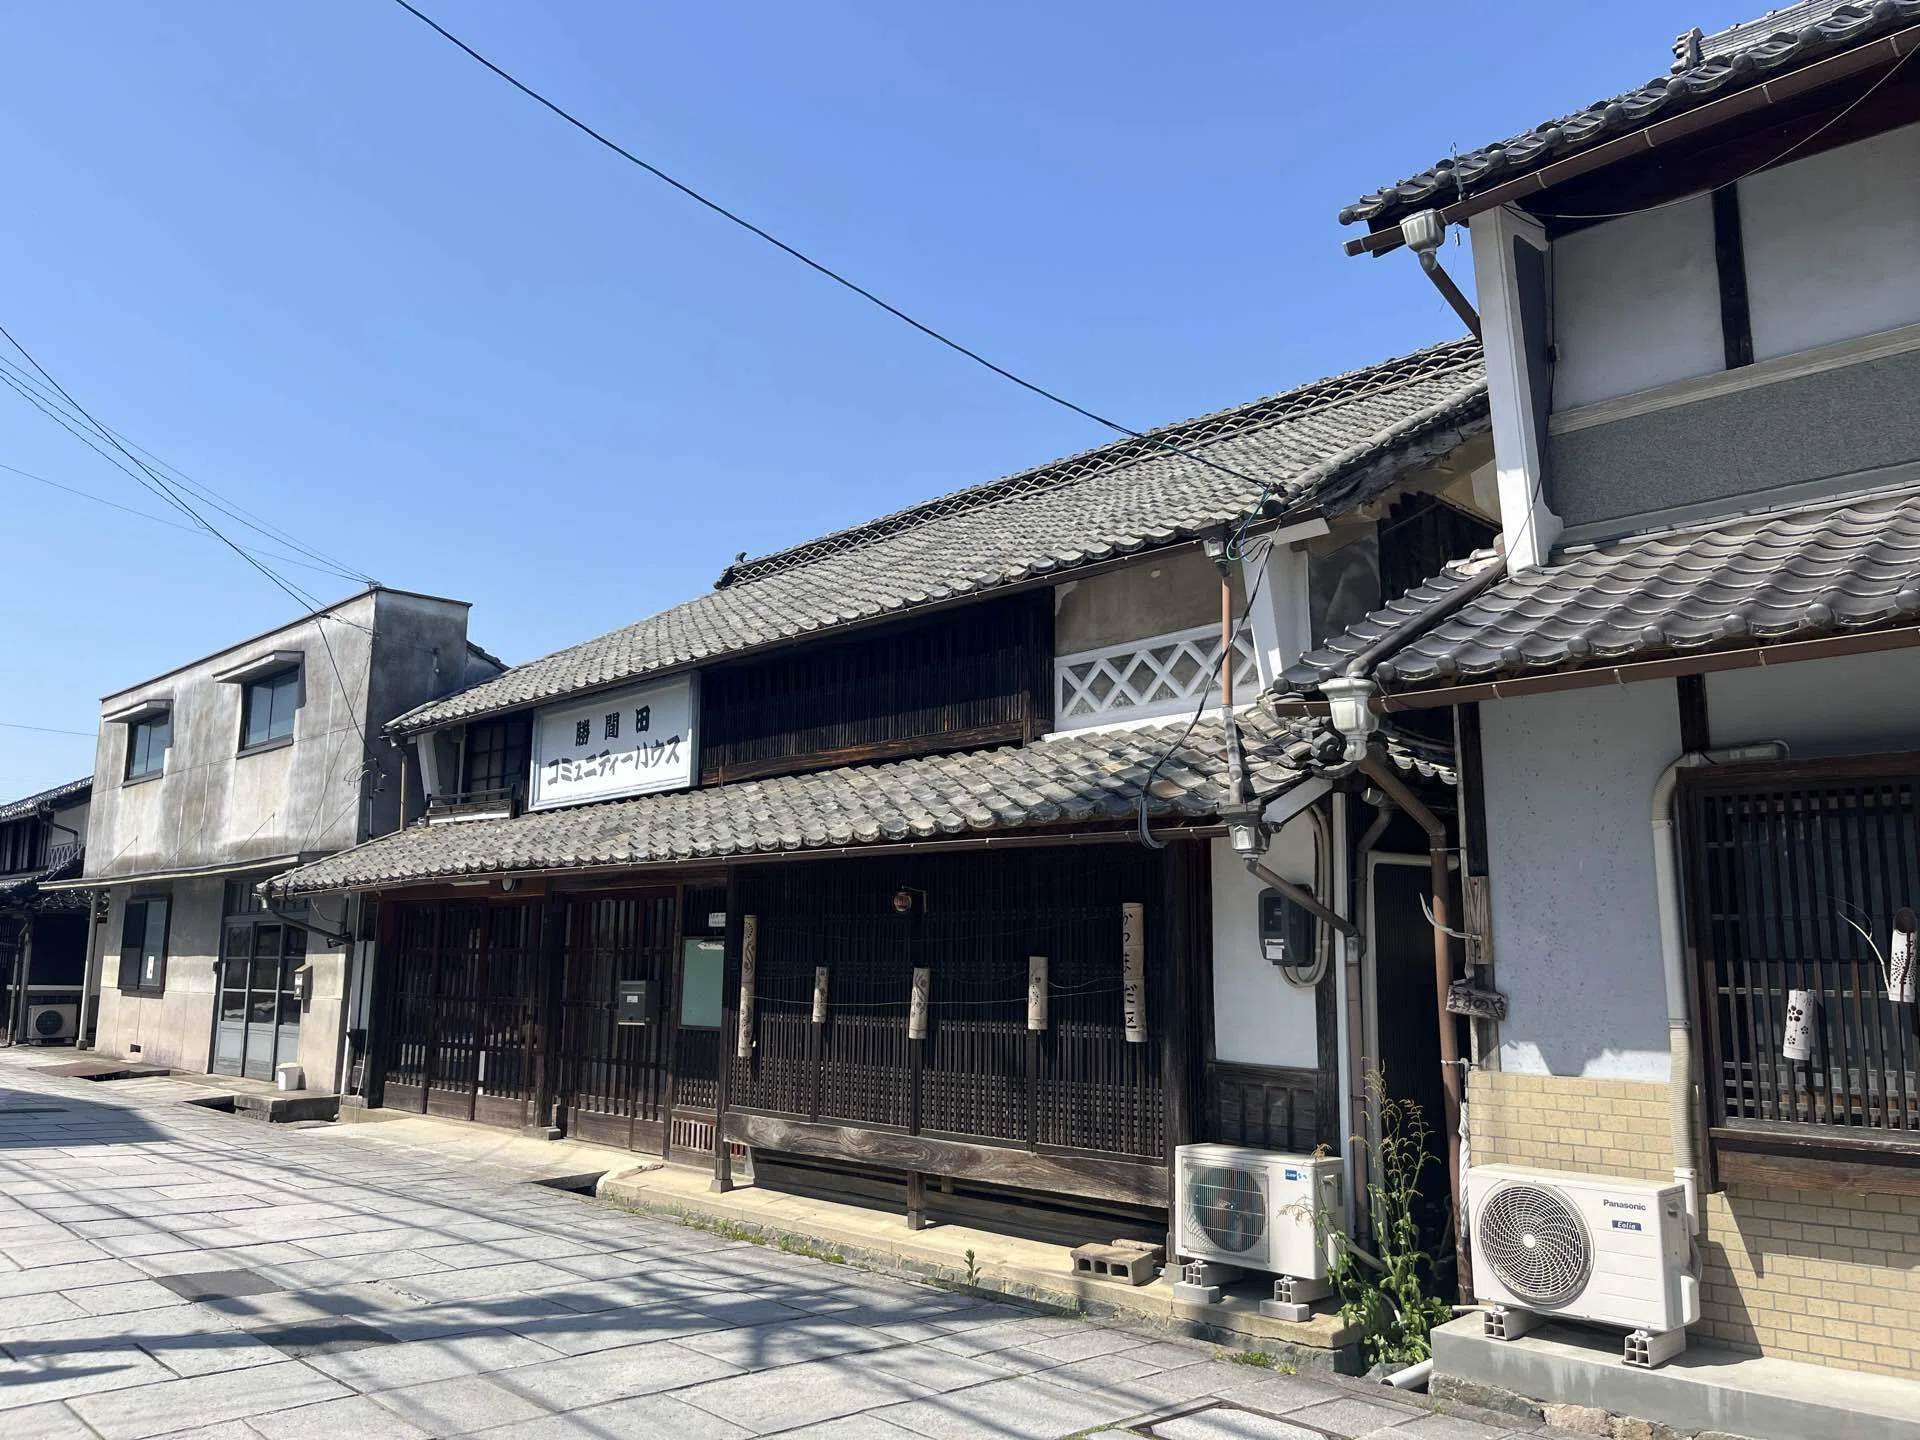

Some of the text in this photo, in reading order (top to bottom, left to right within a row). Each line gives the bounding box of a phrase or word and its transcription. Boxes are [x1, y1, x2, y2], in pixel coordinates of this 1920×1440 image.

[576, 705, 650, 746] 勝間田
[548, 735, 680, 785] コミュニティーハウス
[1603, 1198, 1646, 1211] Panasonic
